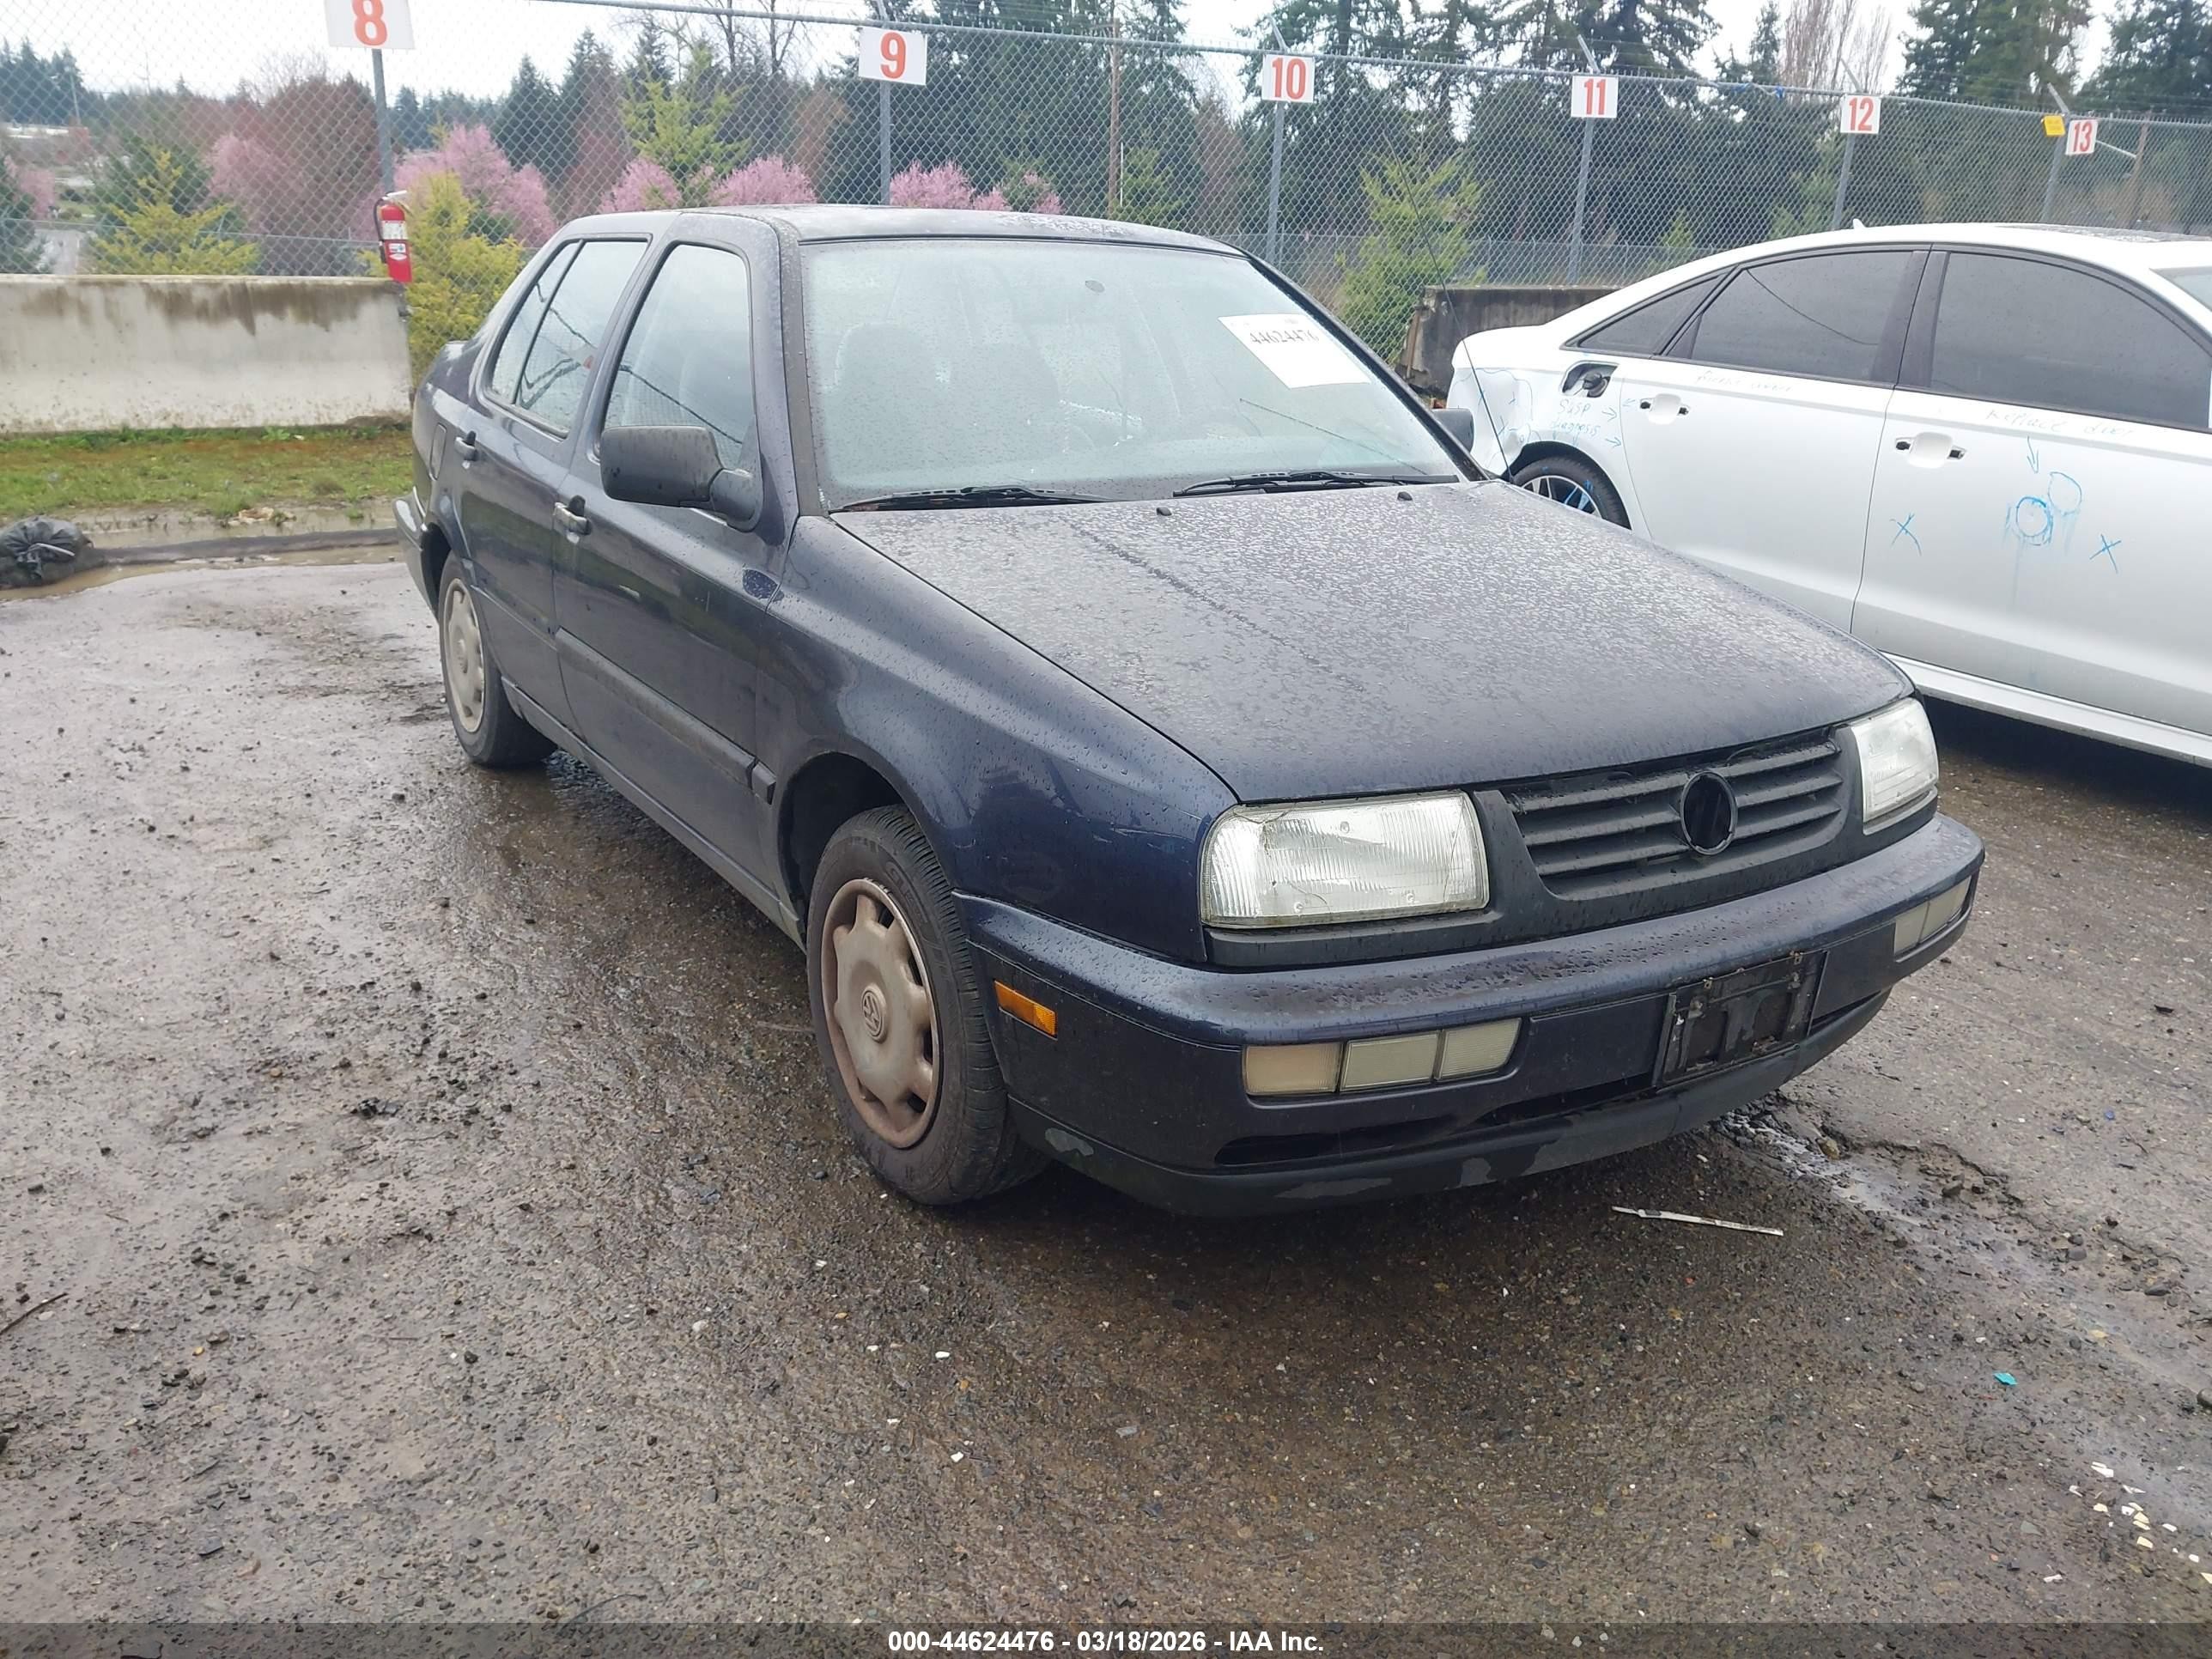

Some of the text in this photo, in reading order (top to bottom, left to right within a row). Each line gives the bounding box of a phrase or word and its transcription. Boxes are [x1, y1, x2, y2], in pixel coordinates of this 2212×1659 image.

[354, 0, 387, 46] 8
[880, 32, 907, 79] 9
[1273, 58, 1306, 99] 10
[1585, 78, 1607, 115] 11
[1848, 97, 1874, 131] 12
[2073, 120, 2093, 153] 13
